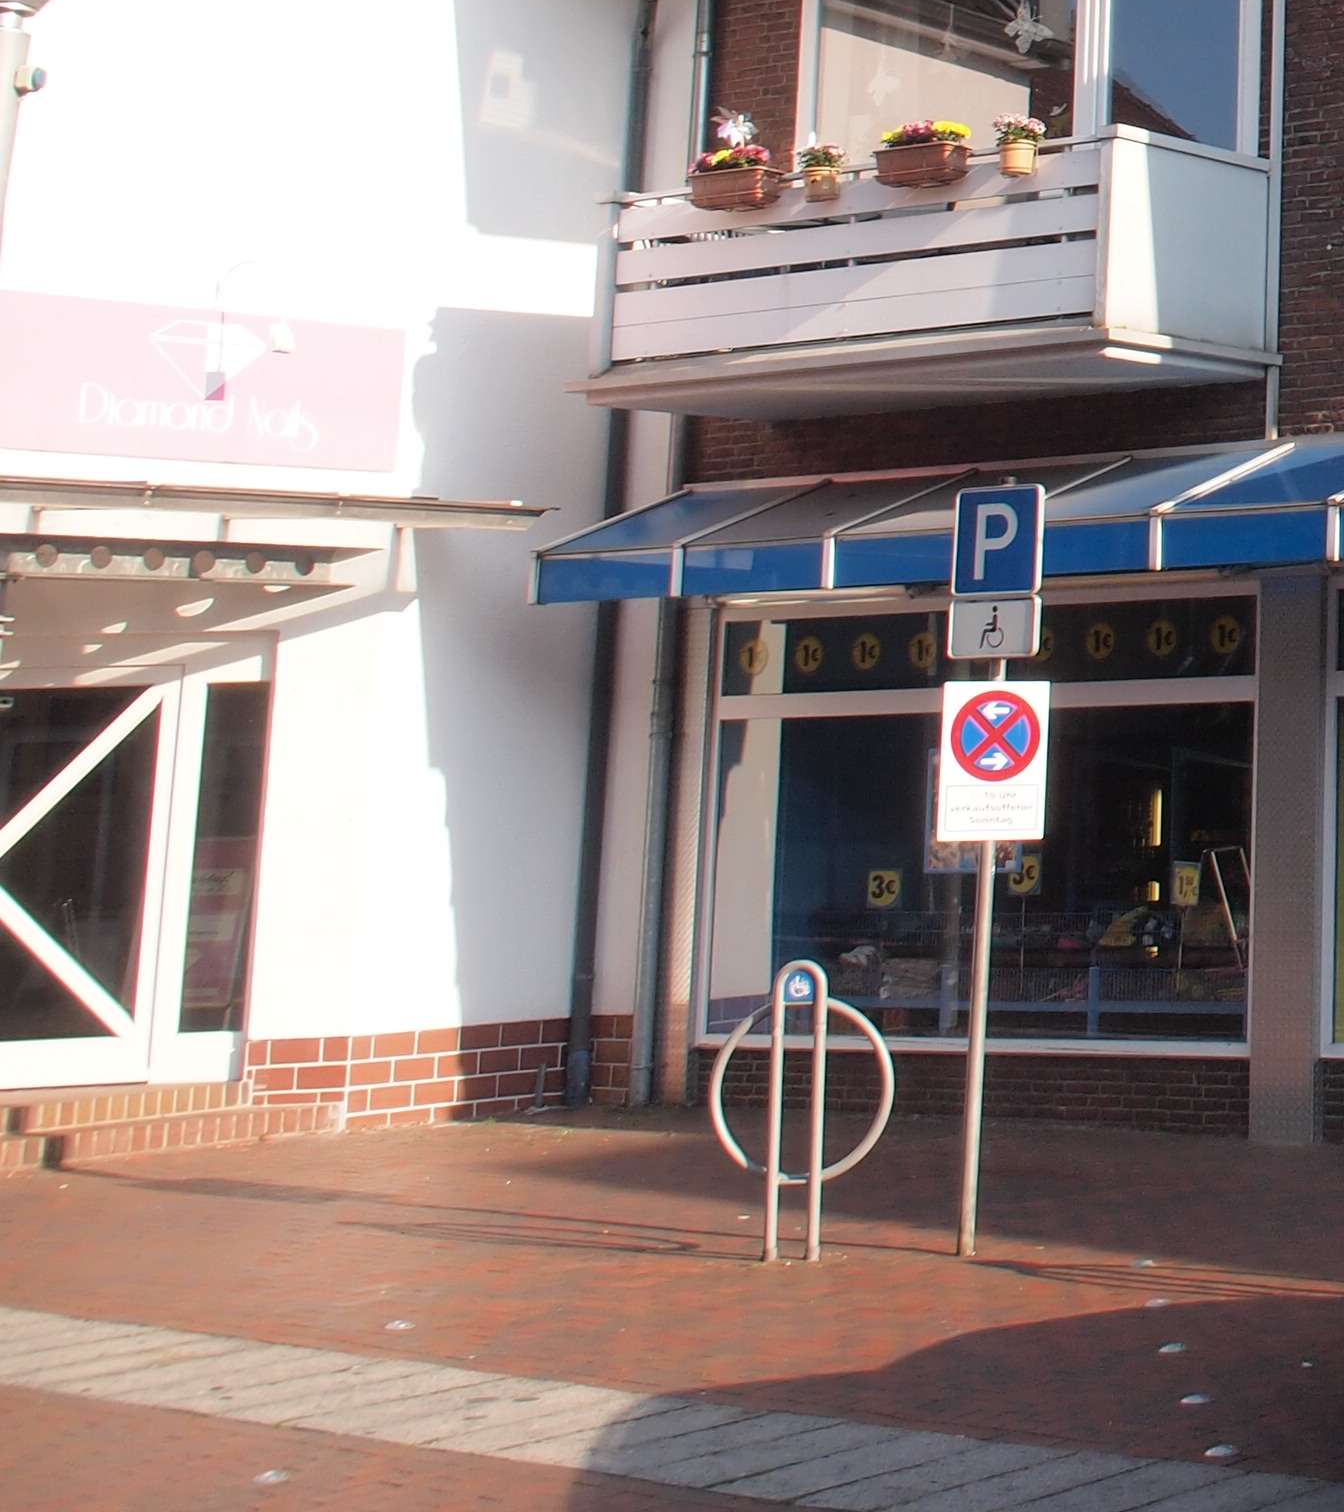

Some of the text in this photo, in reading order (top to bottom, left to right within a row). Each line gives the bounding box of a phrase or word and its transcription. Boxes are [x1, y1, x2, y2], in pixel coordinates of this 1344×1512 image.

[72, 381, 236, 434] Diamond
[973, 502, 1019, 581] P
[871, 874, 897, 899] 3€
